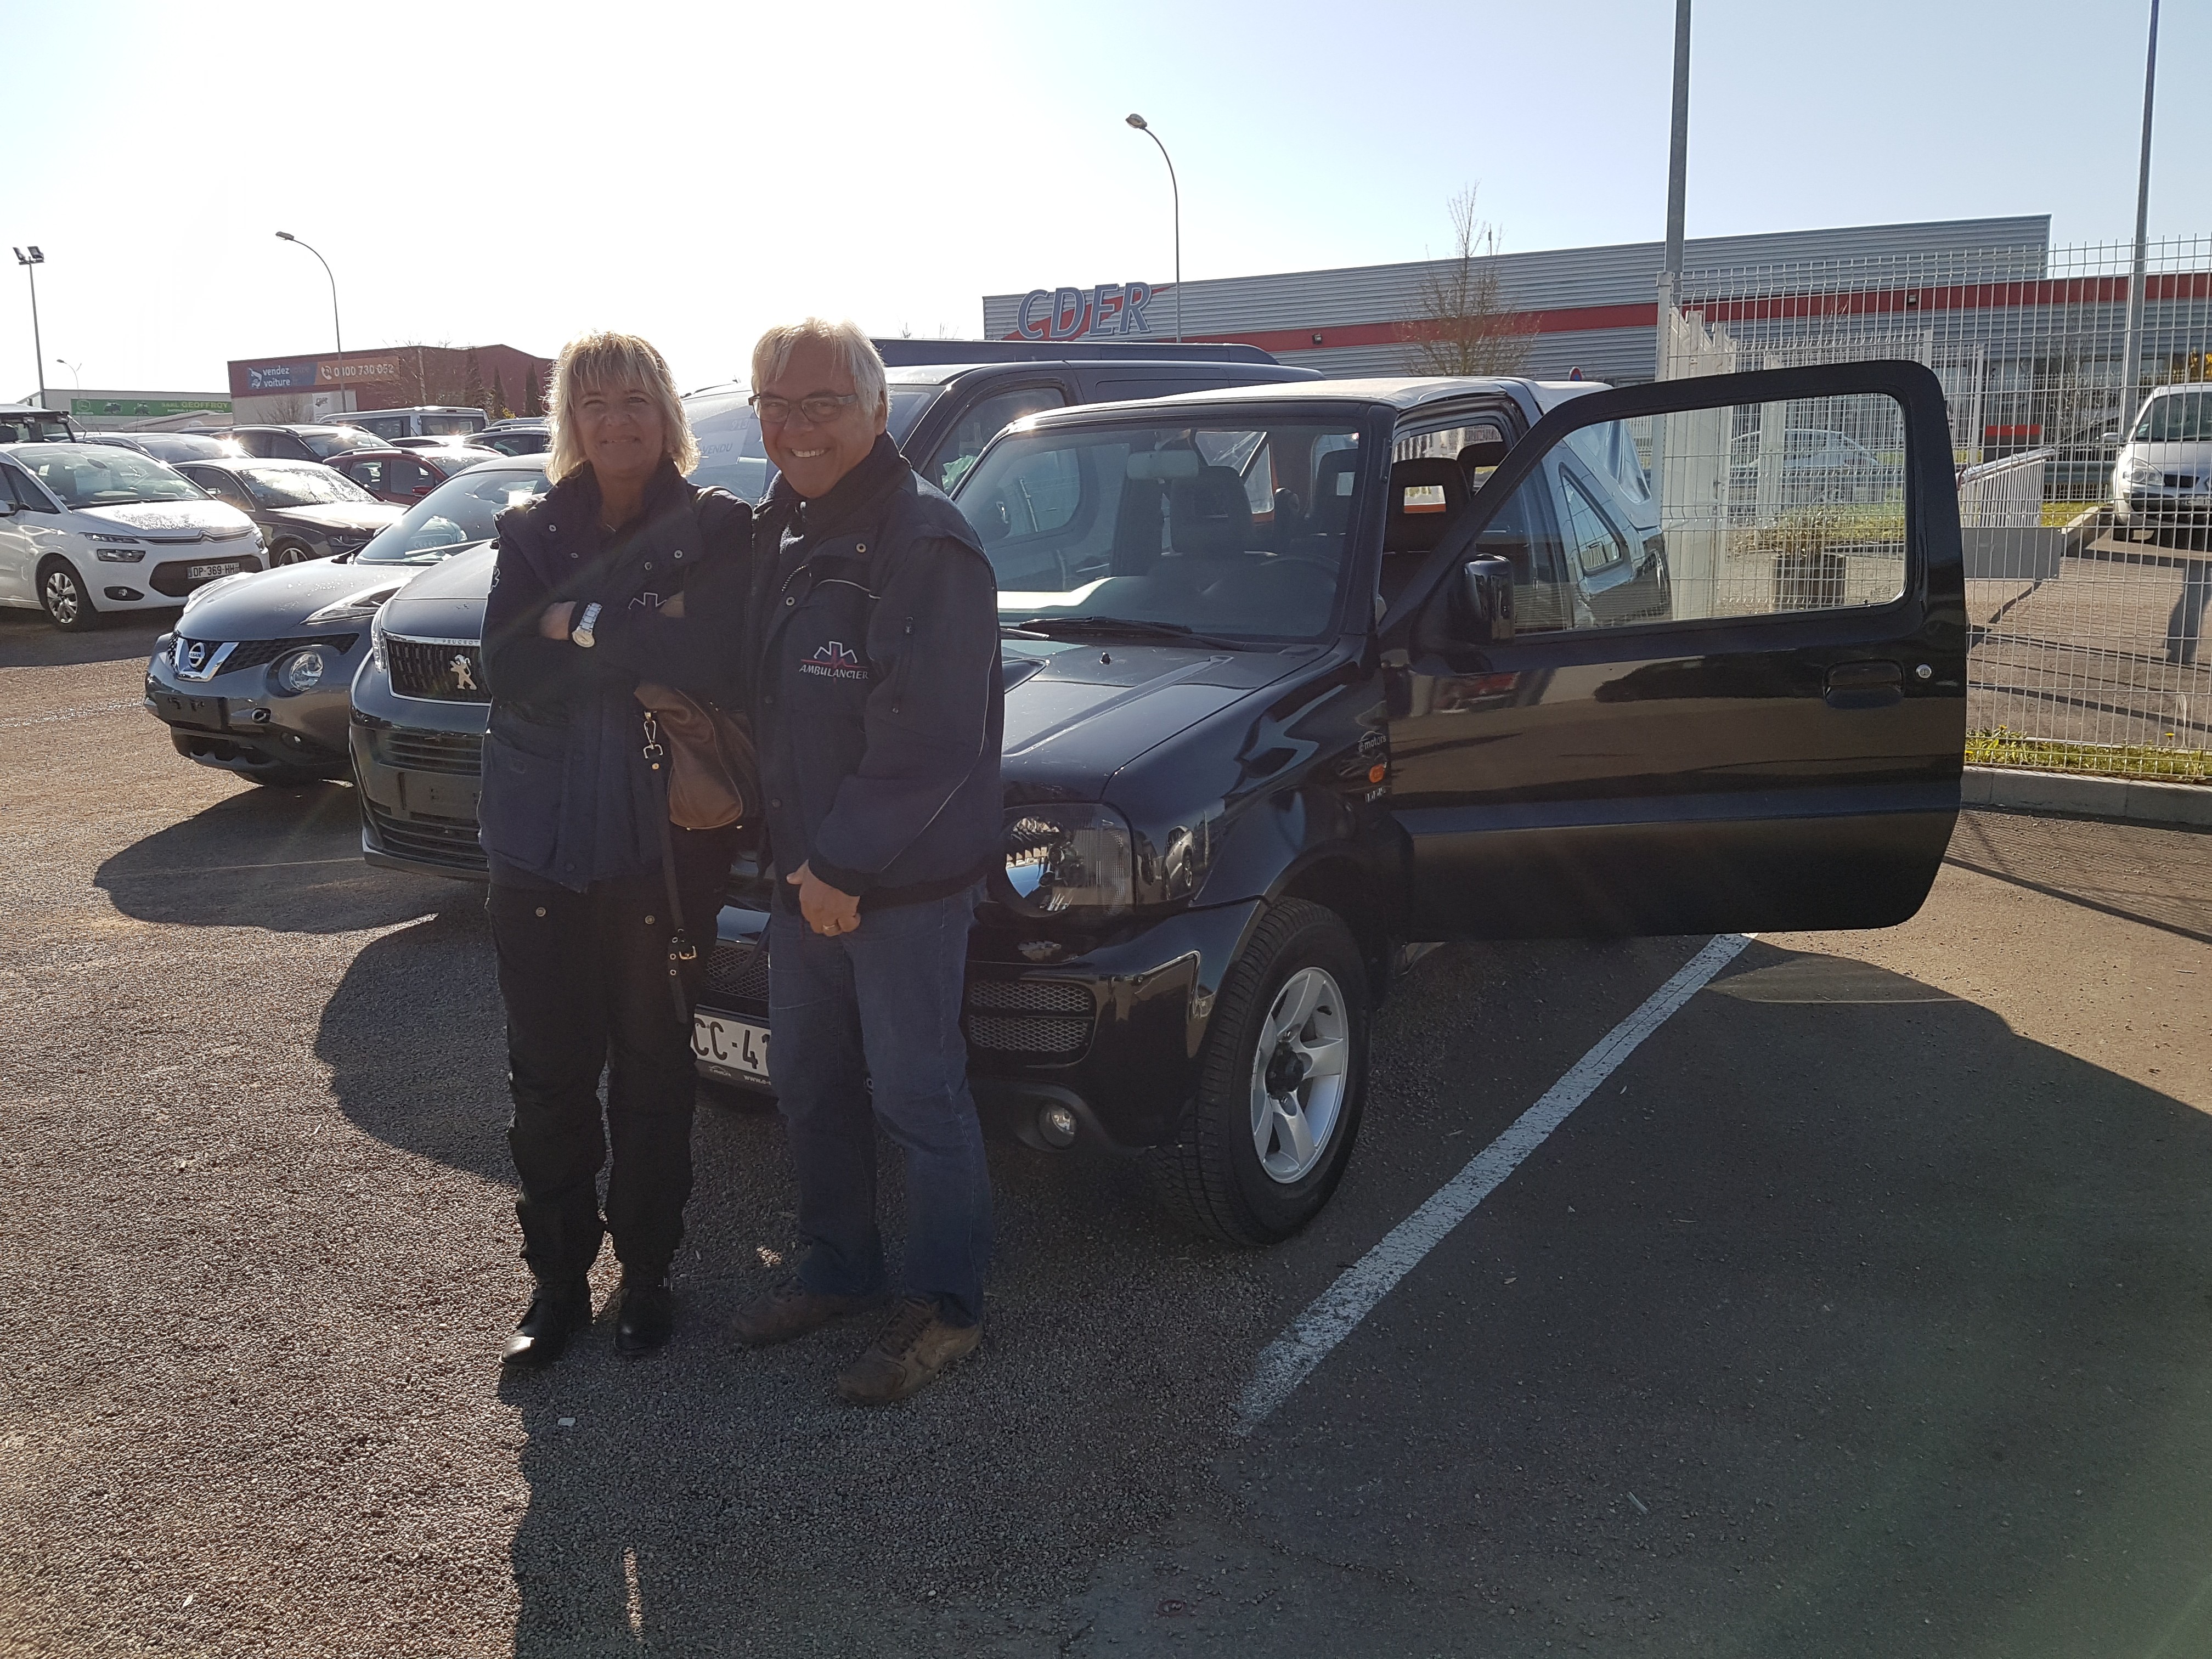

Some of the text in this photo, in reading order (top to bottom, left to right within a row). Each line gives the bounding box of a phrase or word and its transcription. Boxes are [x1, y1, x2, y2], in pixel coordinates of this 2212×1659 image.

[1017, 281, 1153, 340] CDER
[262, 365, 290, 376] vendez
[358, 365, 375, 375] 730
[702, 442, 733, 454] VENDU
[193, 565, 234, 577] DP-369-HH
[799, 664, 869, 679] AMBULANCIER
[692, 1018, 770, 1069] CC-4
